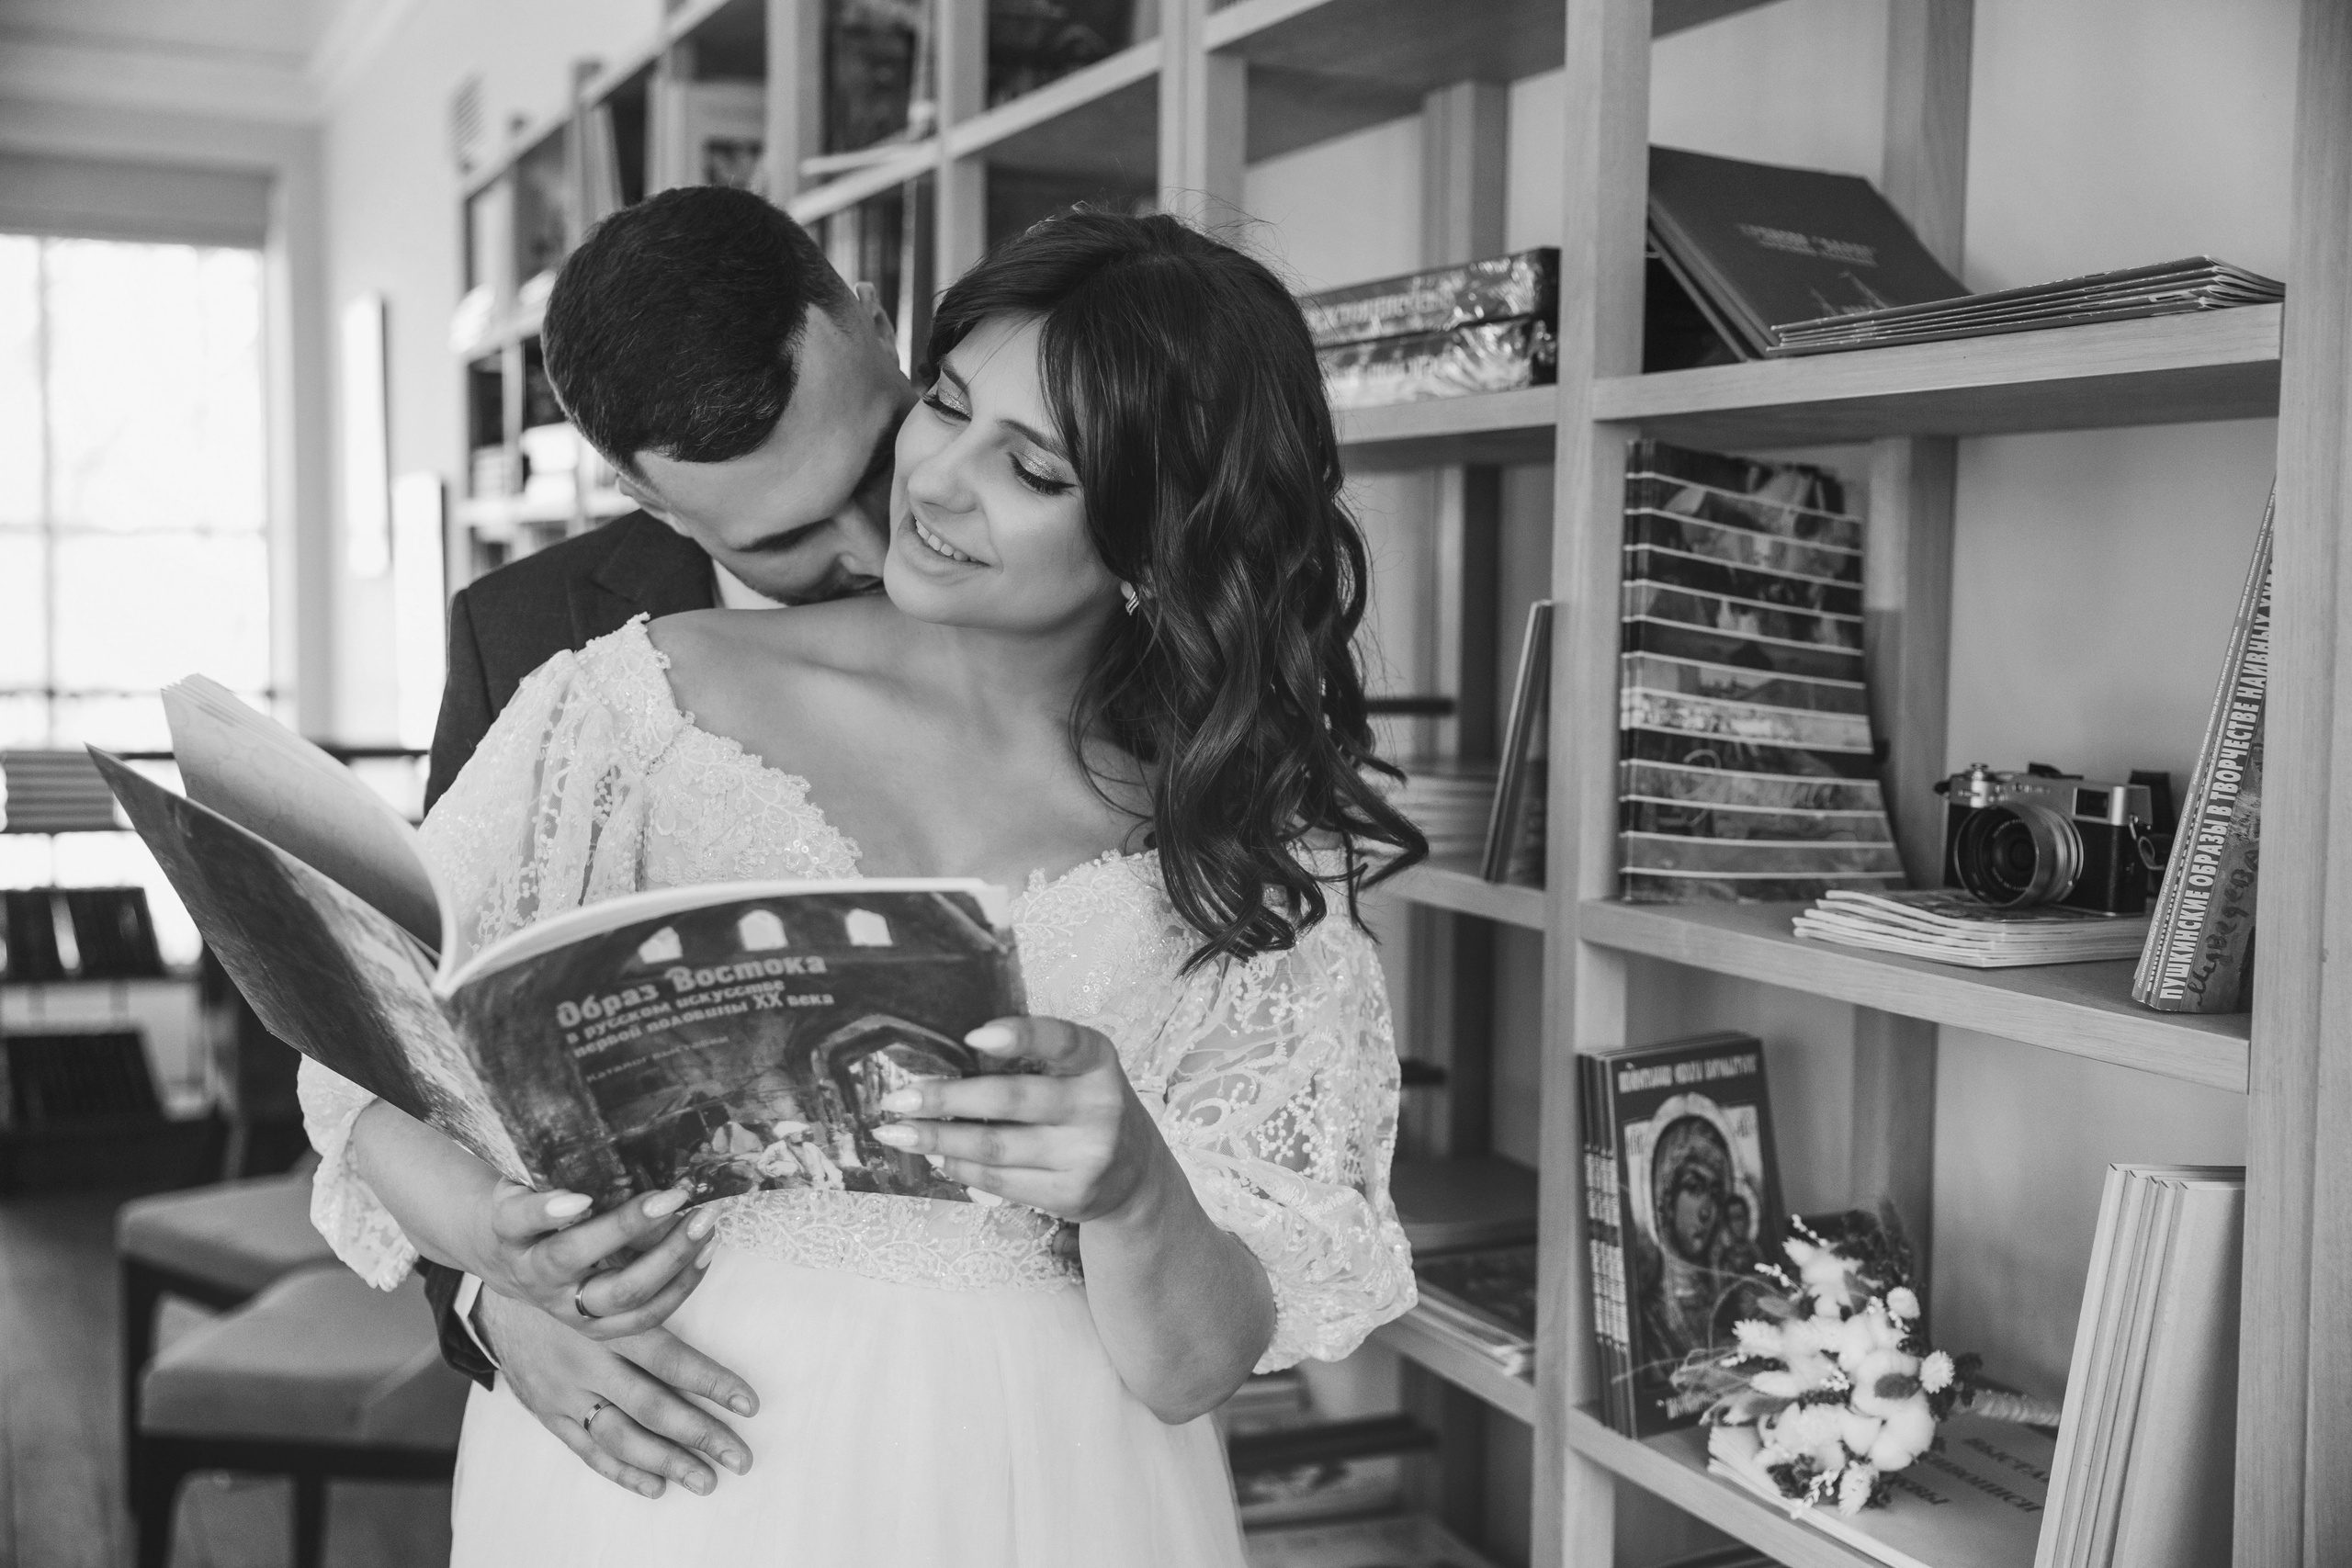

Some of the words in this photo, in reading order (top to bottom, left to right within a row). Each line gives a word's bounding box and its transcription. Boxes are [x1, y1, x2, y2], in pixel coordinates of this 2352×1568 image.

[2237, 594, 2247, 617] IMAGES
[2246, 551, 2258, 585] POUCHKINE
[2192, 753, 2204, 784] PUSHKIN'S
[2200, 731, 2210, 753] IMAGES
[2206, 705, 2217, 731] CREATED
[2221, 656, 2230, 680] ARTISTS
[2230, 626, 2238, 647] RUSSIA
[2210, 701, 2259, 800] ТВОРЧЕСТВЕ
[2206, 805, 2230, 816] В
[2189, 818, 2228, 887] ОБРАЗЫ
[2137, 949, 2151, 987] ПУШКИНСКИЕ
[2147, 925, 2157, 949] ОБРАЗЫ
[2154, 885, 2168, 920] ТВОРЧЕСТВЕ
[2165, 857, 2176, 885] НАИВНЫХ
[2172, 817, 2187, 856] ХУДОЖНИКОВ
[2183, 792, 2193, 817] РОССИИ
[2159, 886, 2210, 998] ПУШКИНСКИЕ
[556, 984, 659, 1027] Образ
[664, 956, 827, 993] Востока
[573, 1024, 643, 1057] первой
[646, 1001, 749, 1032] половины
[786, 994, 834, 1007] века
[583, 1002, 673, 1040] русском
[676, 980, 786, 1009] искусстве
